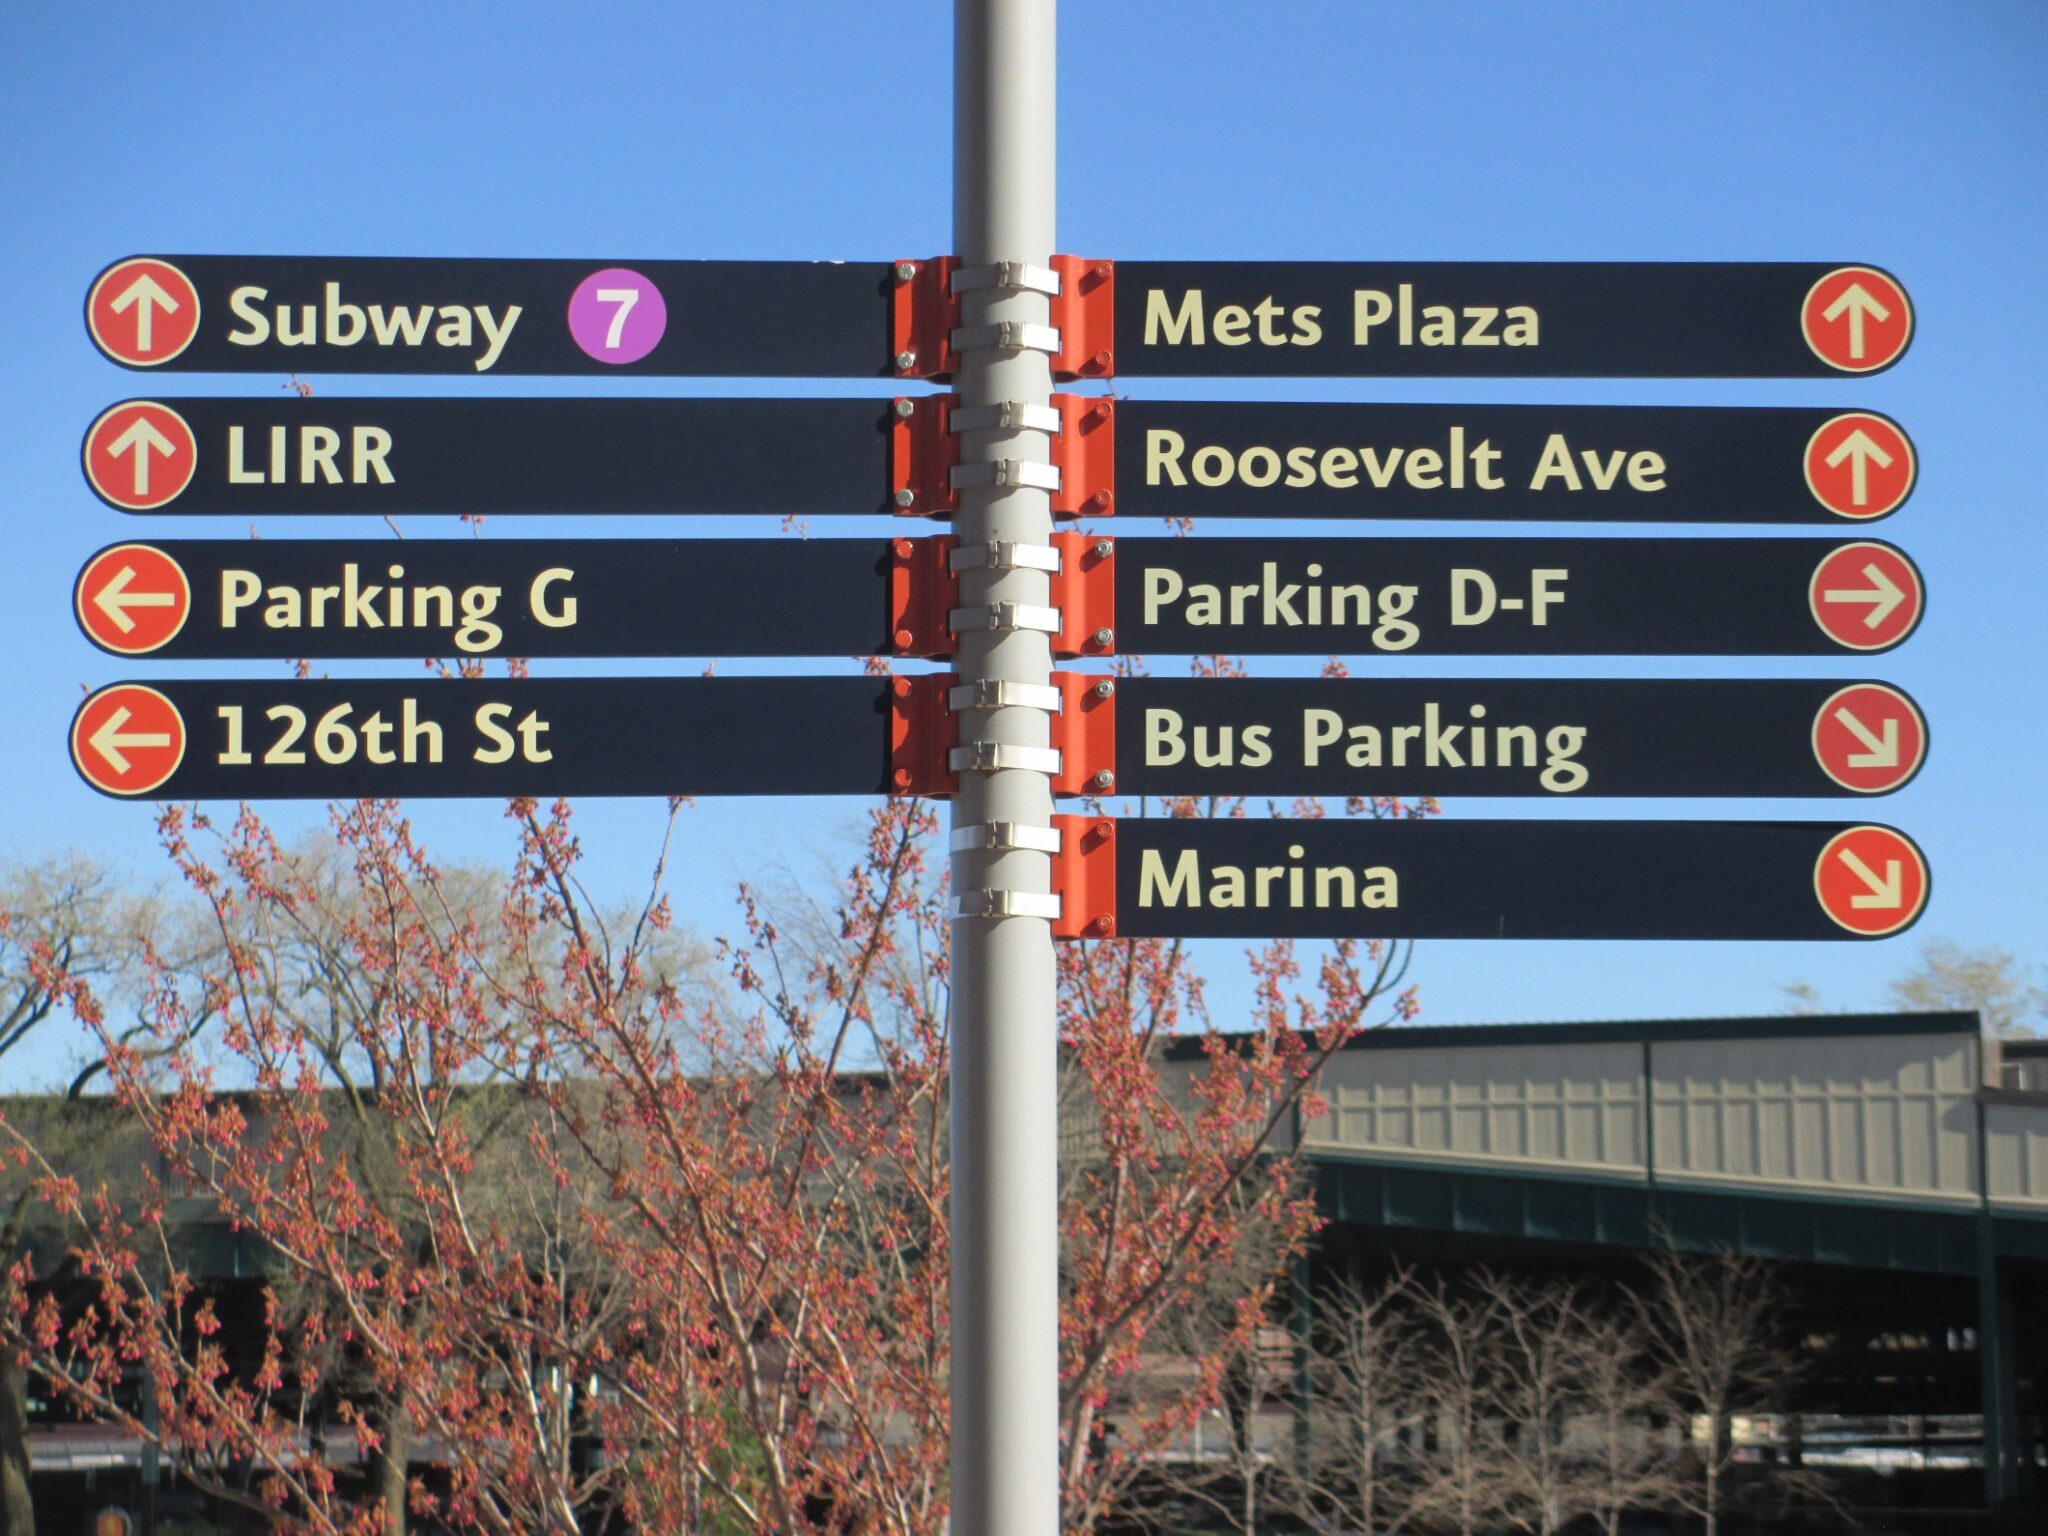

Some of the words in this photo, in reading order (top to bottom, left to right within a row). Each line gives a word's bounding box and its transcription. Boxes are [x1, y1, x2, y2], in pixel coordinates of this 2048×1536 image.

[228, 281, 523, 371] Subway
[596, 288, 640, 349] 7
[1144, 289, 1322, 346] Mets
[1354, 283, 1540, 347] Plaza
[228, 425, 396, 484] LIRR
[1146, 426, 1505, 490] Roosevelt
[1529, 434, 1667, 492] Ave
[221, 563, 503, 653] Parking
[529, 567, 578, 629] G
[1143, 561, 1420, 651] Parking
[1450, 568, 1569, 626] D-F
[217, 698, 443, 765] 126th
[473, 702, 554, 764] St
[1145, 708, 1273, 768] Bus
[1303, 702, 1589, 793] Parking
[1138, 844, 1399, 910] Marina
